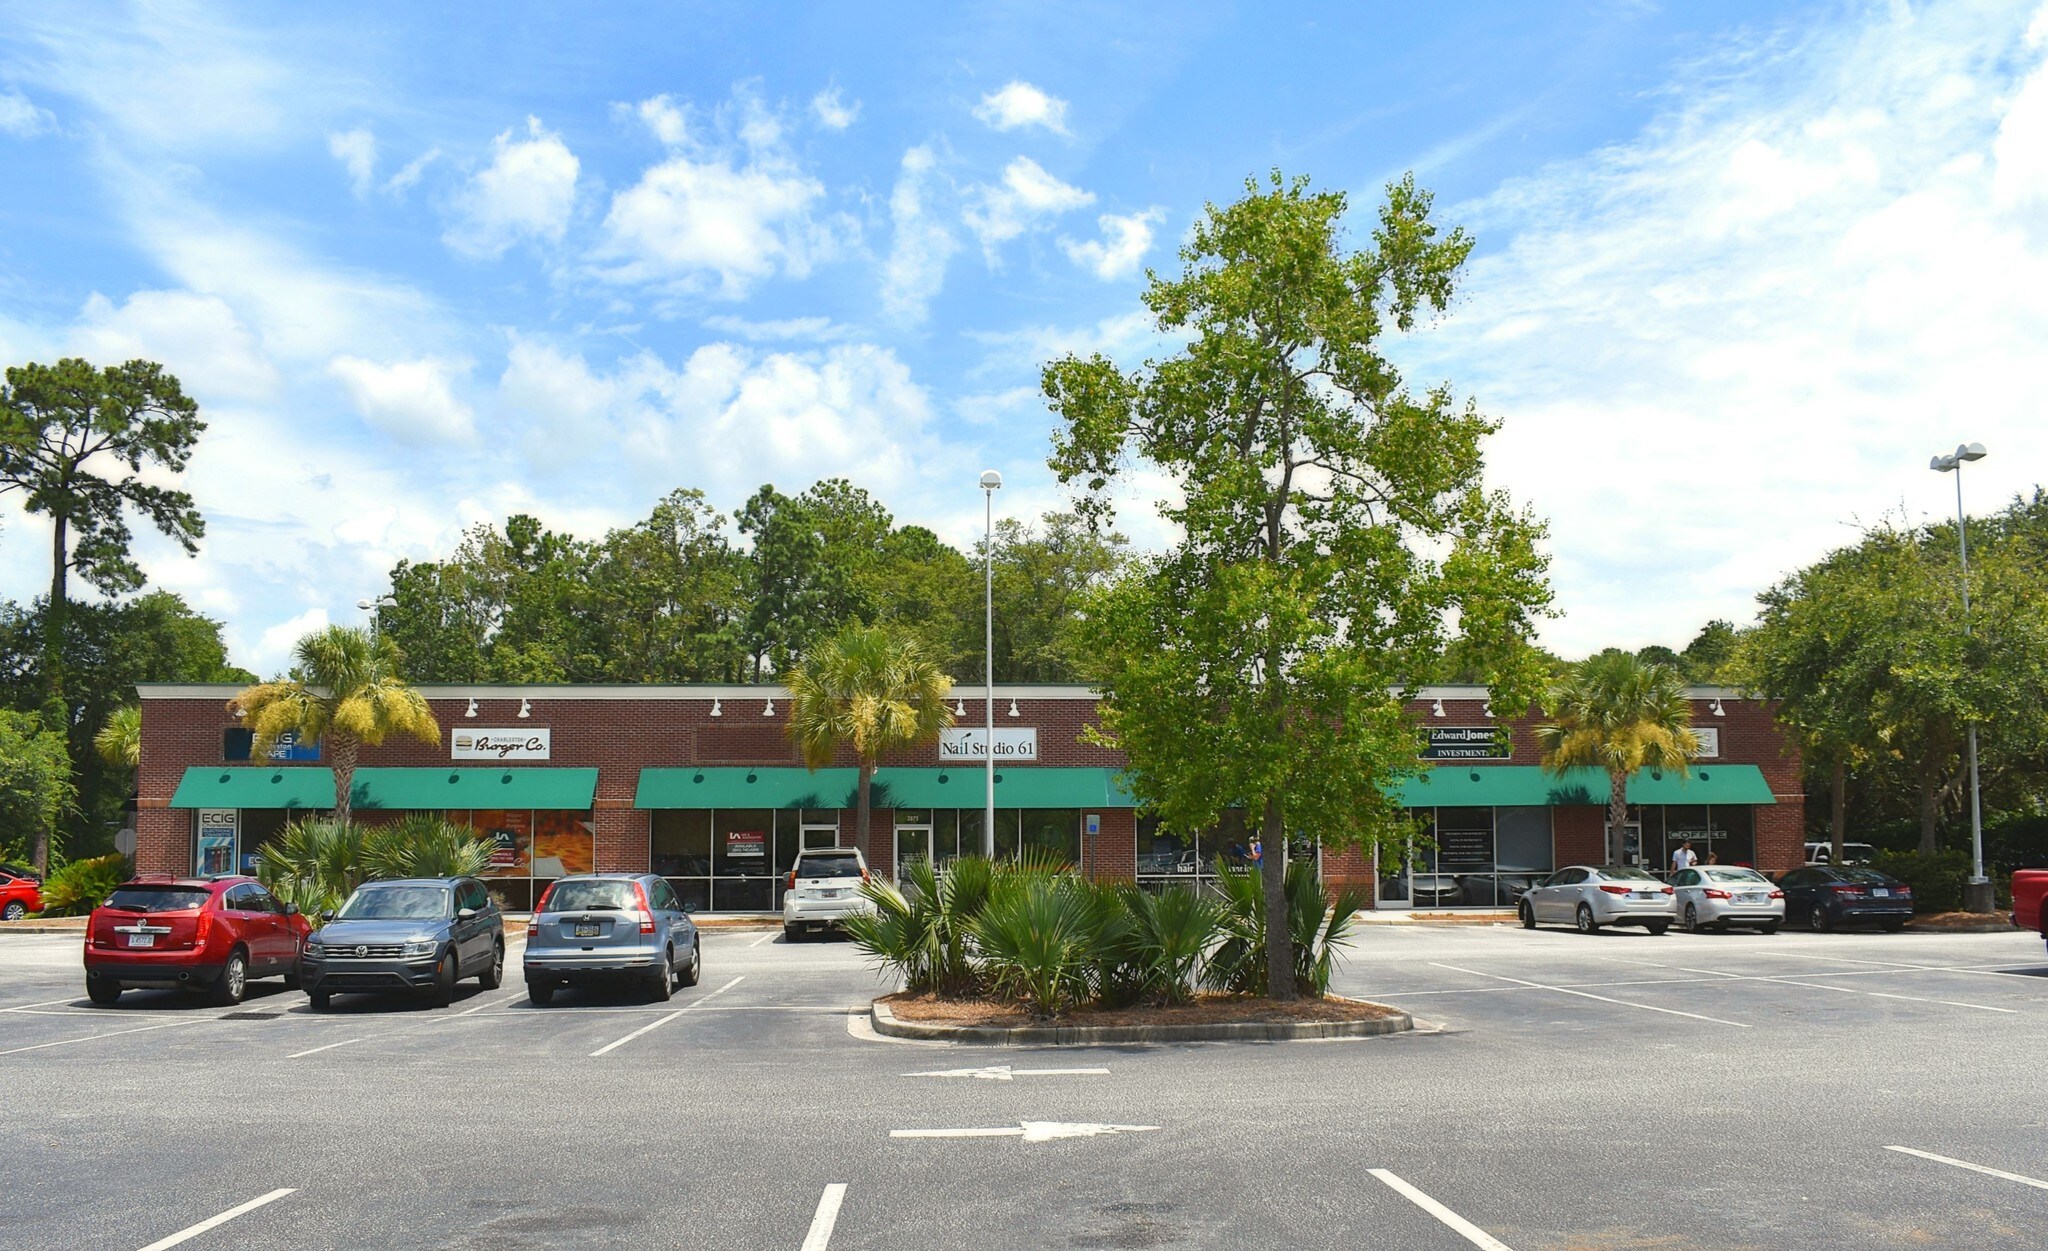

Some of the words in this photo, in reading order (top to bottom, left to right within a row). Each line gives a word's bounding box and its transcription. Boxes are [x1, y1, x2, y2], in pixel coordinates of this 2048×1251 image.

[475, 737, 524, 757] Burger
[525, 737, 546, 751] Co.
[942, 742, 968, 754] Nail
[972, 742, 1014, 754] Stdio
[1018, 741, 1033, 754] 61
[1669, 831, 1726, 839] COFFEE
[1176, 862, 1195, 873] hair
